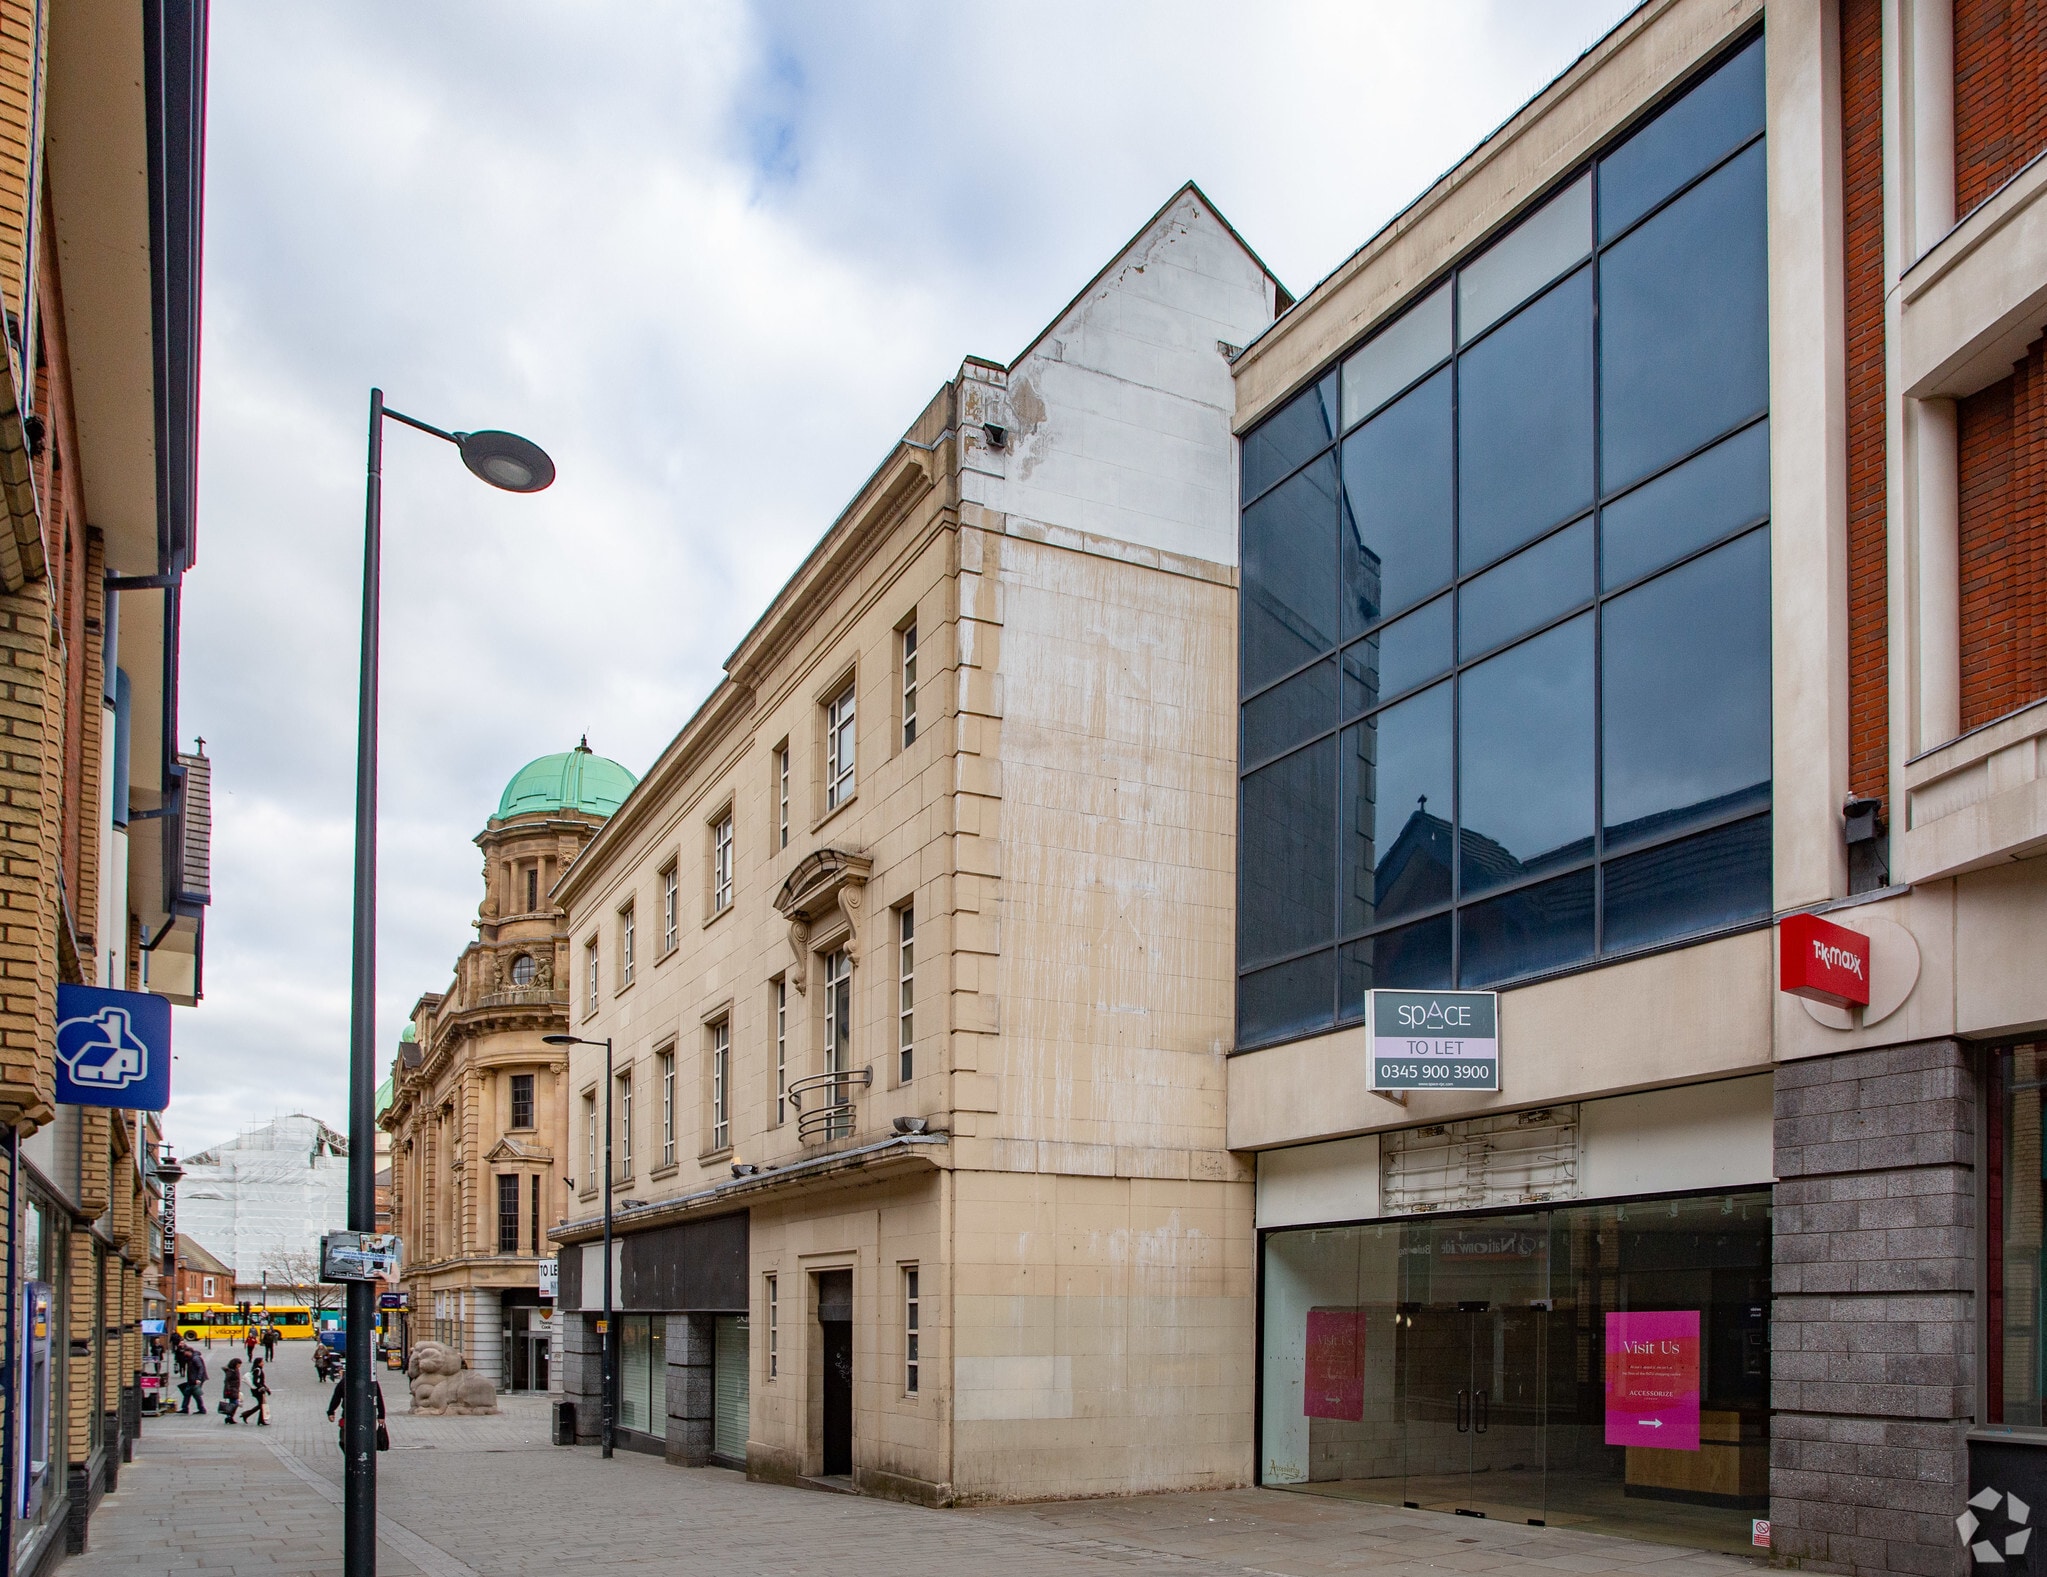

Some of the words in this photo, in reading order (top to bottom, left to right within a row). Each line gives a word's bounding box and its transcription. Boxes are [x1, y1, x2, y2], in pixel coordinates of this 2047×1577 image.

[1406, 1040, 1428, 1055] TO
[1435, 1040, 1464, 1055] LET
[1381, 1065, 1418, 1079] 0345
[1422, 1065, 1450, 1079] 900
[1453, 1065, 1489, 1079] 3900
[164, 1183, 175, 1238] LONGLAND
[164, 1239, 175, 1254] LEE
[540, 1265, 548, 1276] TO
[550, 1265, 558, 1276] LE
[1623, 1340, 1654, 1354] Visit
[1661, 1341, 1680, 1354] Us
